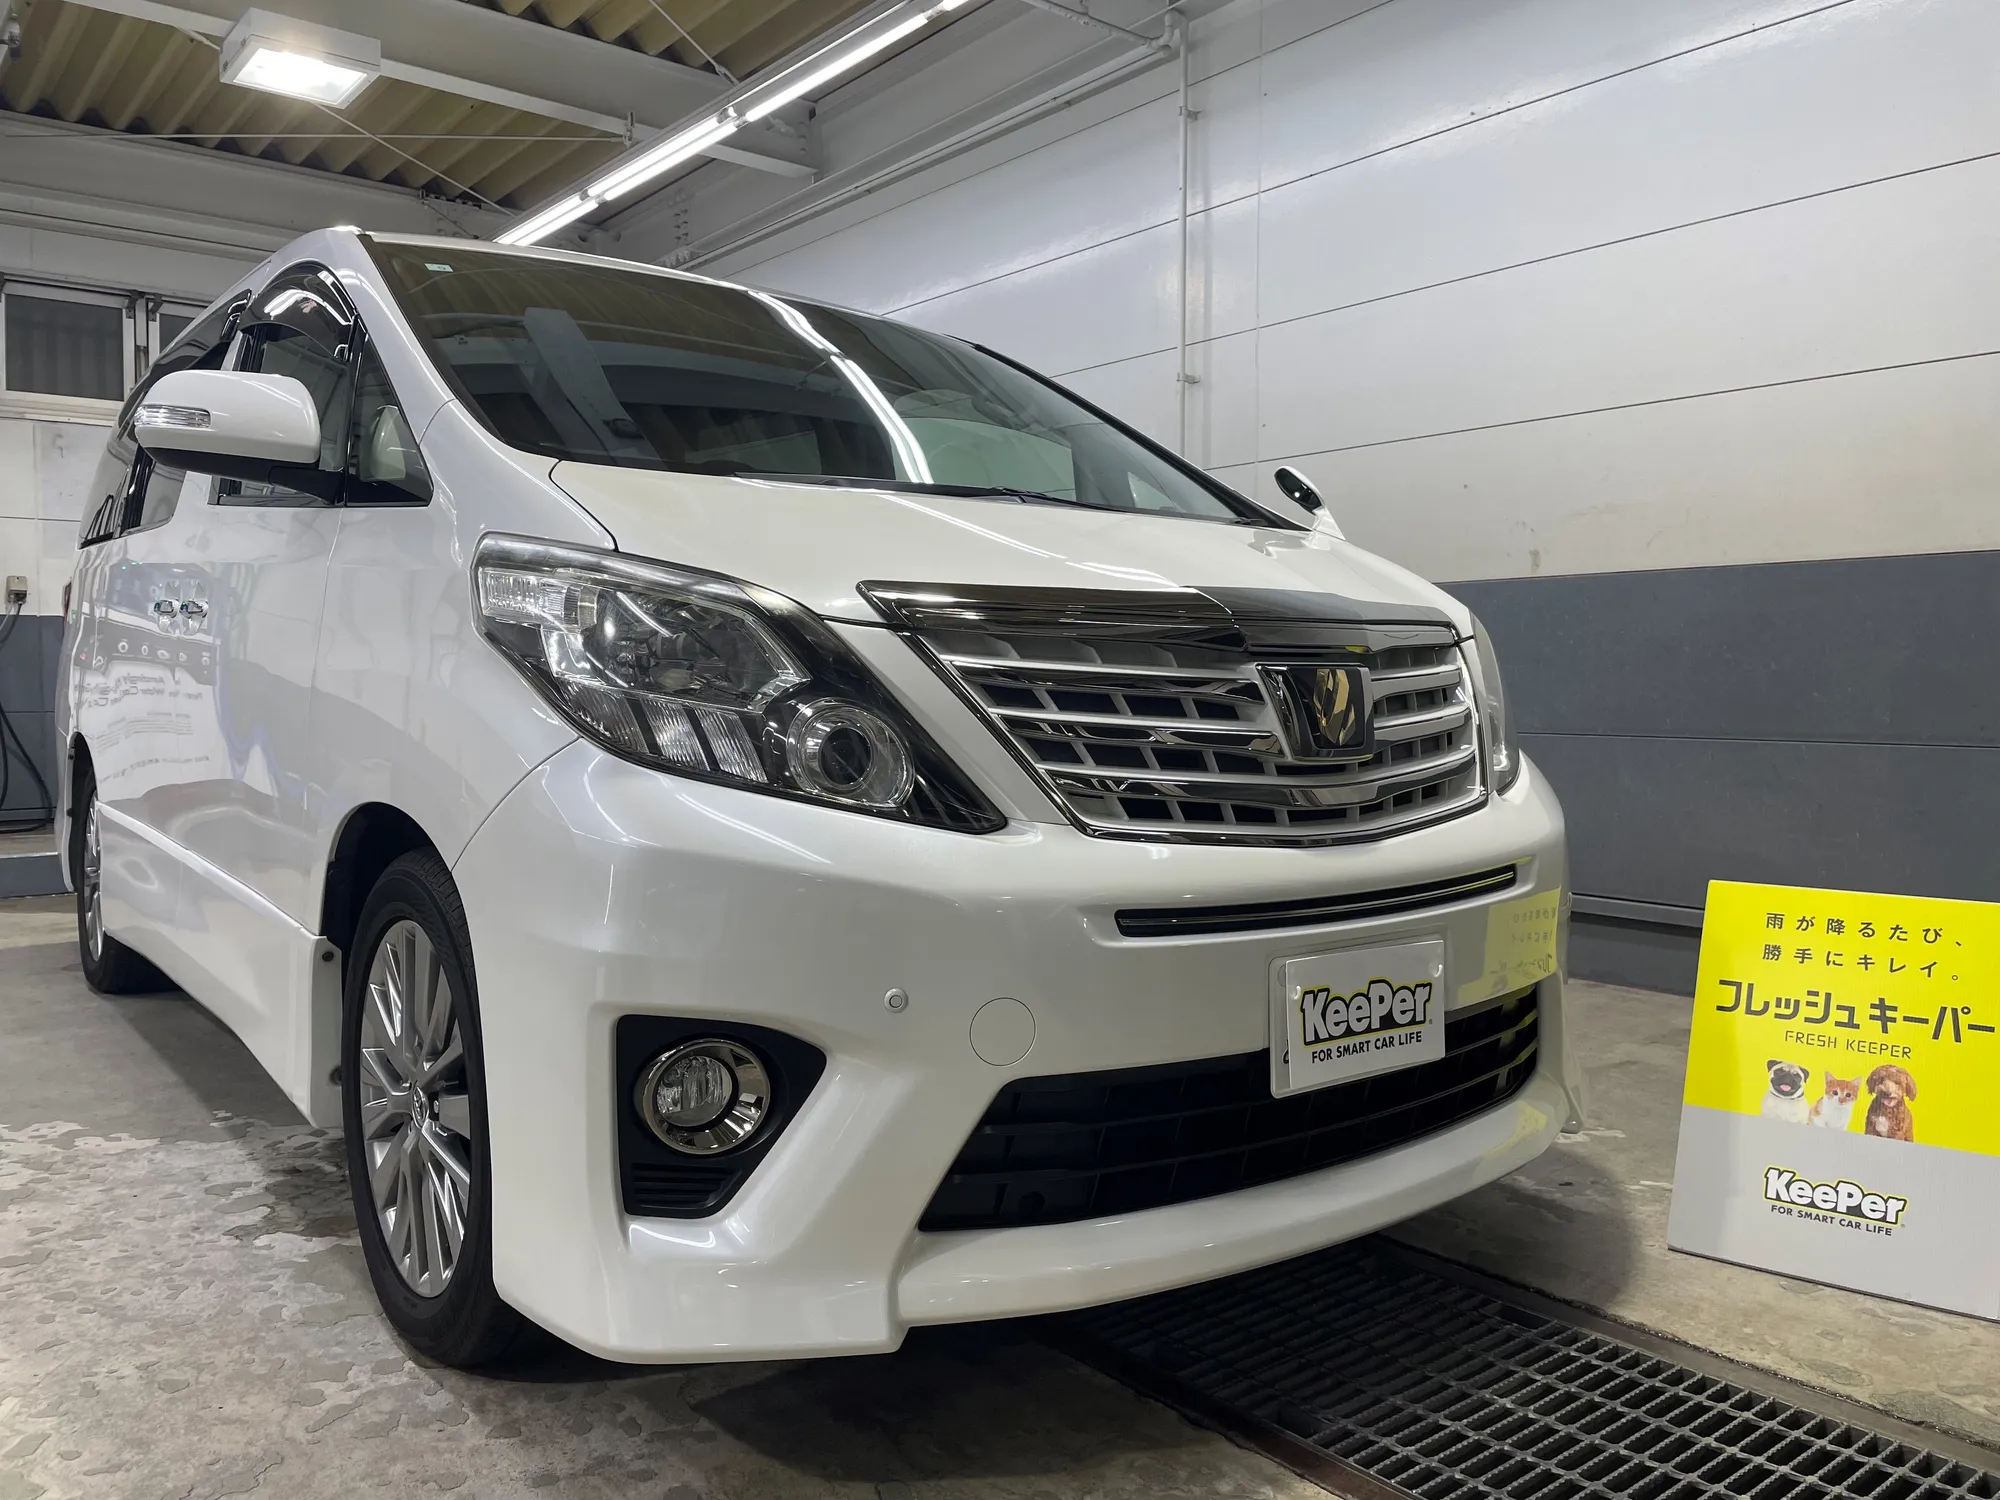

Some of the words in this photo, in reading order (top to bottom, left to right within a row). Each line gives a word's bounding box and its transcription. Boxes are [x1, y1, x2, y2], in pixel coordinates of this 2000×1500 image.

[1765, 912, 1962, 947] 雨が降るたび、
[1762, 943, 1960, 982] 勝手にキレイ。
[1301, 979, 1432, 1046] KeePer
[1716, 979, 1996, 1044] フレッシュキーパー
[1311, 1050, 1333, 1064] FOR
[1336, 1040, 1371, 1058] SMART
[1374, 1036, 1396, 1050] CAR
[1398, 1031, 1423, 1046] LIFE
[1784, 1030, 1838, 1050] FRESH
[1845, 1039, 1912, 1060] KEEPER
[1764, 1167, 1906, 1225] KeePer
[1771, 1204, 1794, 1217] FOR
[1797, 1210, 1835, 1225] SMART
[1839, 1218, 1862, 1231] CAR
[1865, 1224, 1893, 1237] LIFE
